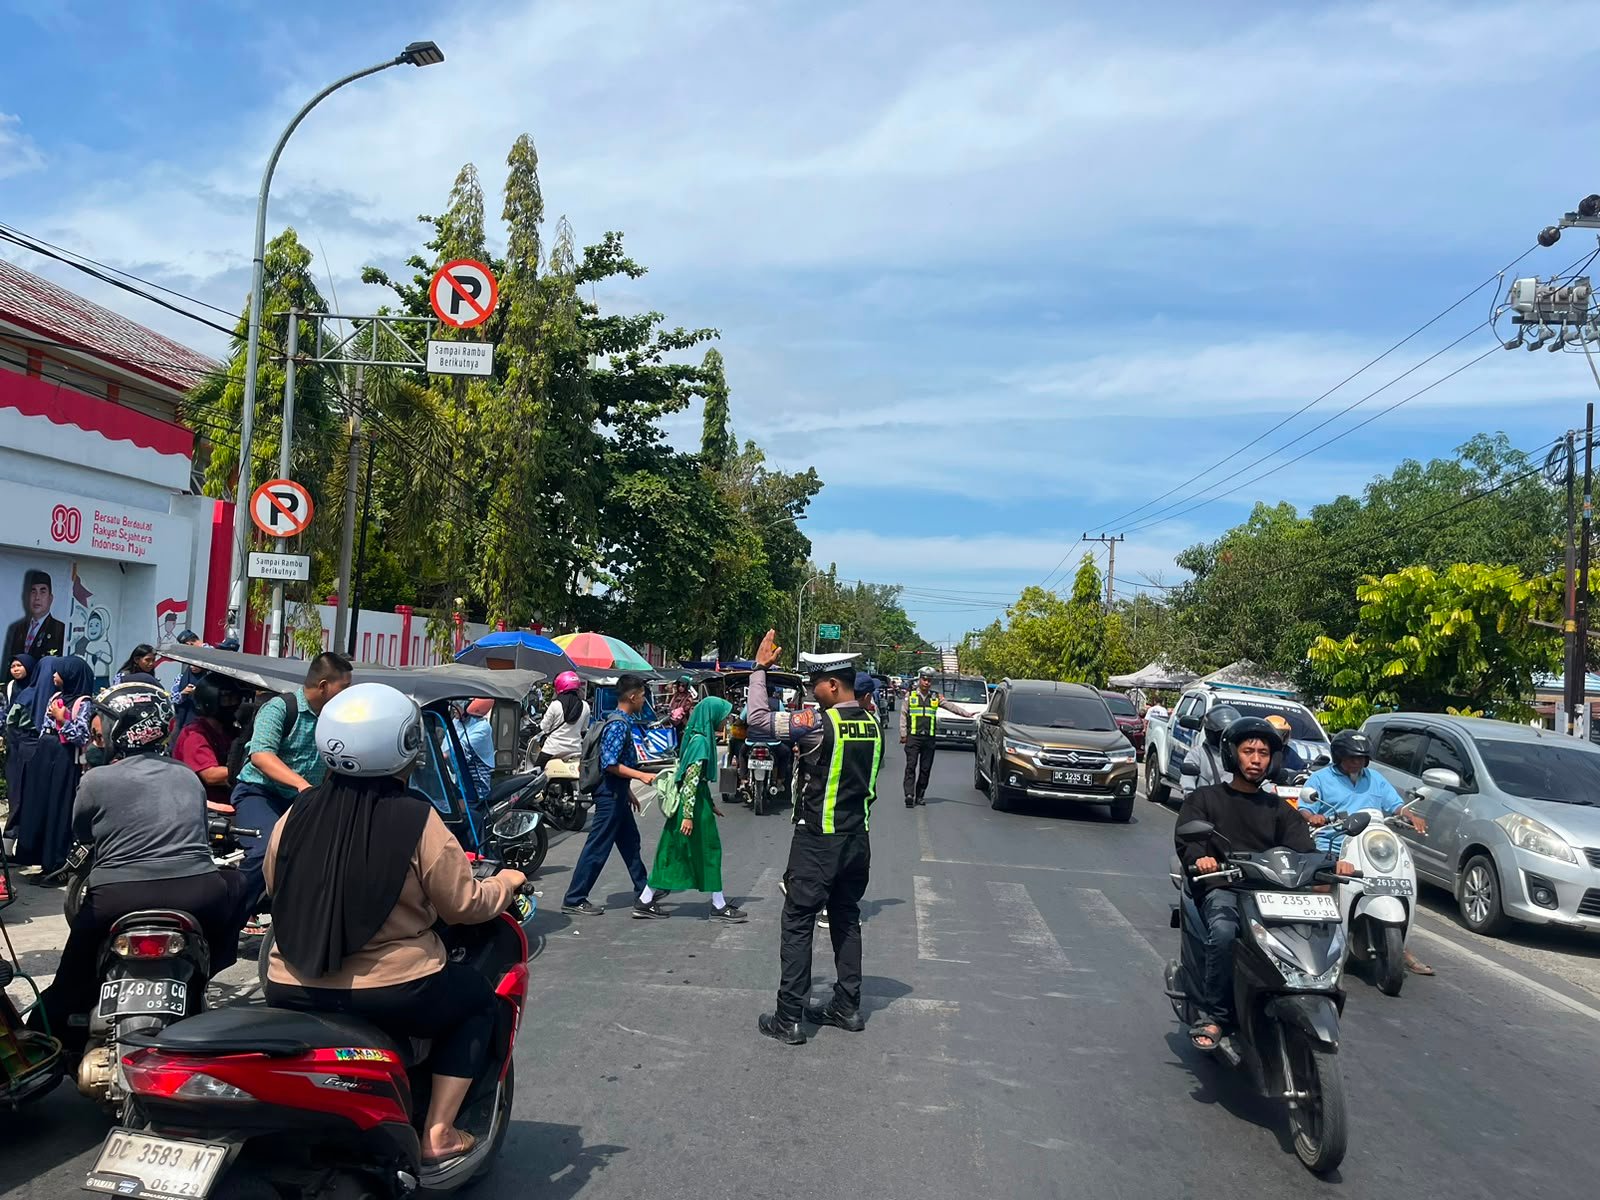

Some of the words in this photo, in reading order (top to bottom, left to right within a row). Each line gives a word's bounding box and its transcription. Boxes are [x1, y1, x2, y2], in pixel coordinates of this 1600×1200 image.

[434, 345, 460, 357] Sampai
[462, 347, 486, 357] Rambu
[439, 357, 479, 370] Berikutnya
[51, 504, 82, 544] 80
[94, 510, 121, 525] Bersatu
[122, 516, 153, 531] Berdaulat
[93, 523, 118, 539] Rakyat
[92, 537, 125, 552] Indonesia
[127, 542, 146, 557] Maju
[256, 557, 280, 567] Sampai
[281, 559, 303, 568] Rambu
[260, 566, 297, 578] Berikutnya
[838, 722, 878, 739] POLISI
[1054, 771, 1062, 779] DC
[1065, 772, 1081, 781] 1235
[1259, 894, 1275, 904] DC
[1281, 895, 1311, 906] 2355
[1317, 896, 1333, 906] PR
[103, 984, 119, 1000] DC
[126, 982, 163, 996] 4876
[107, 1138, 132, 1160] DC
[137, 1143, 182, 1168] 3583
